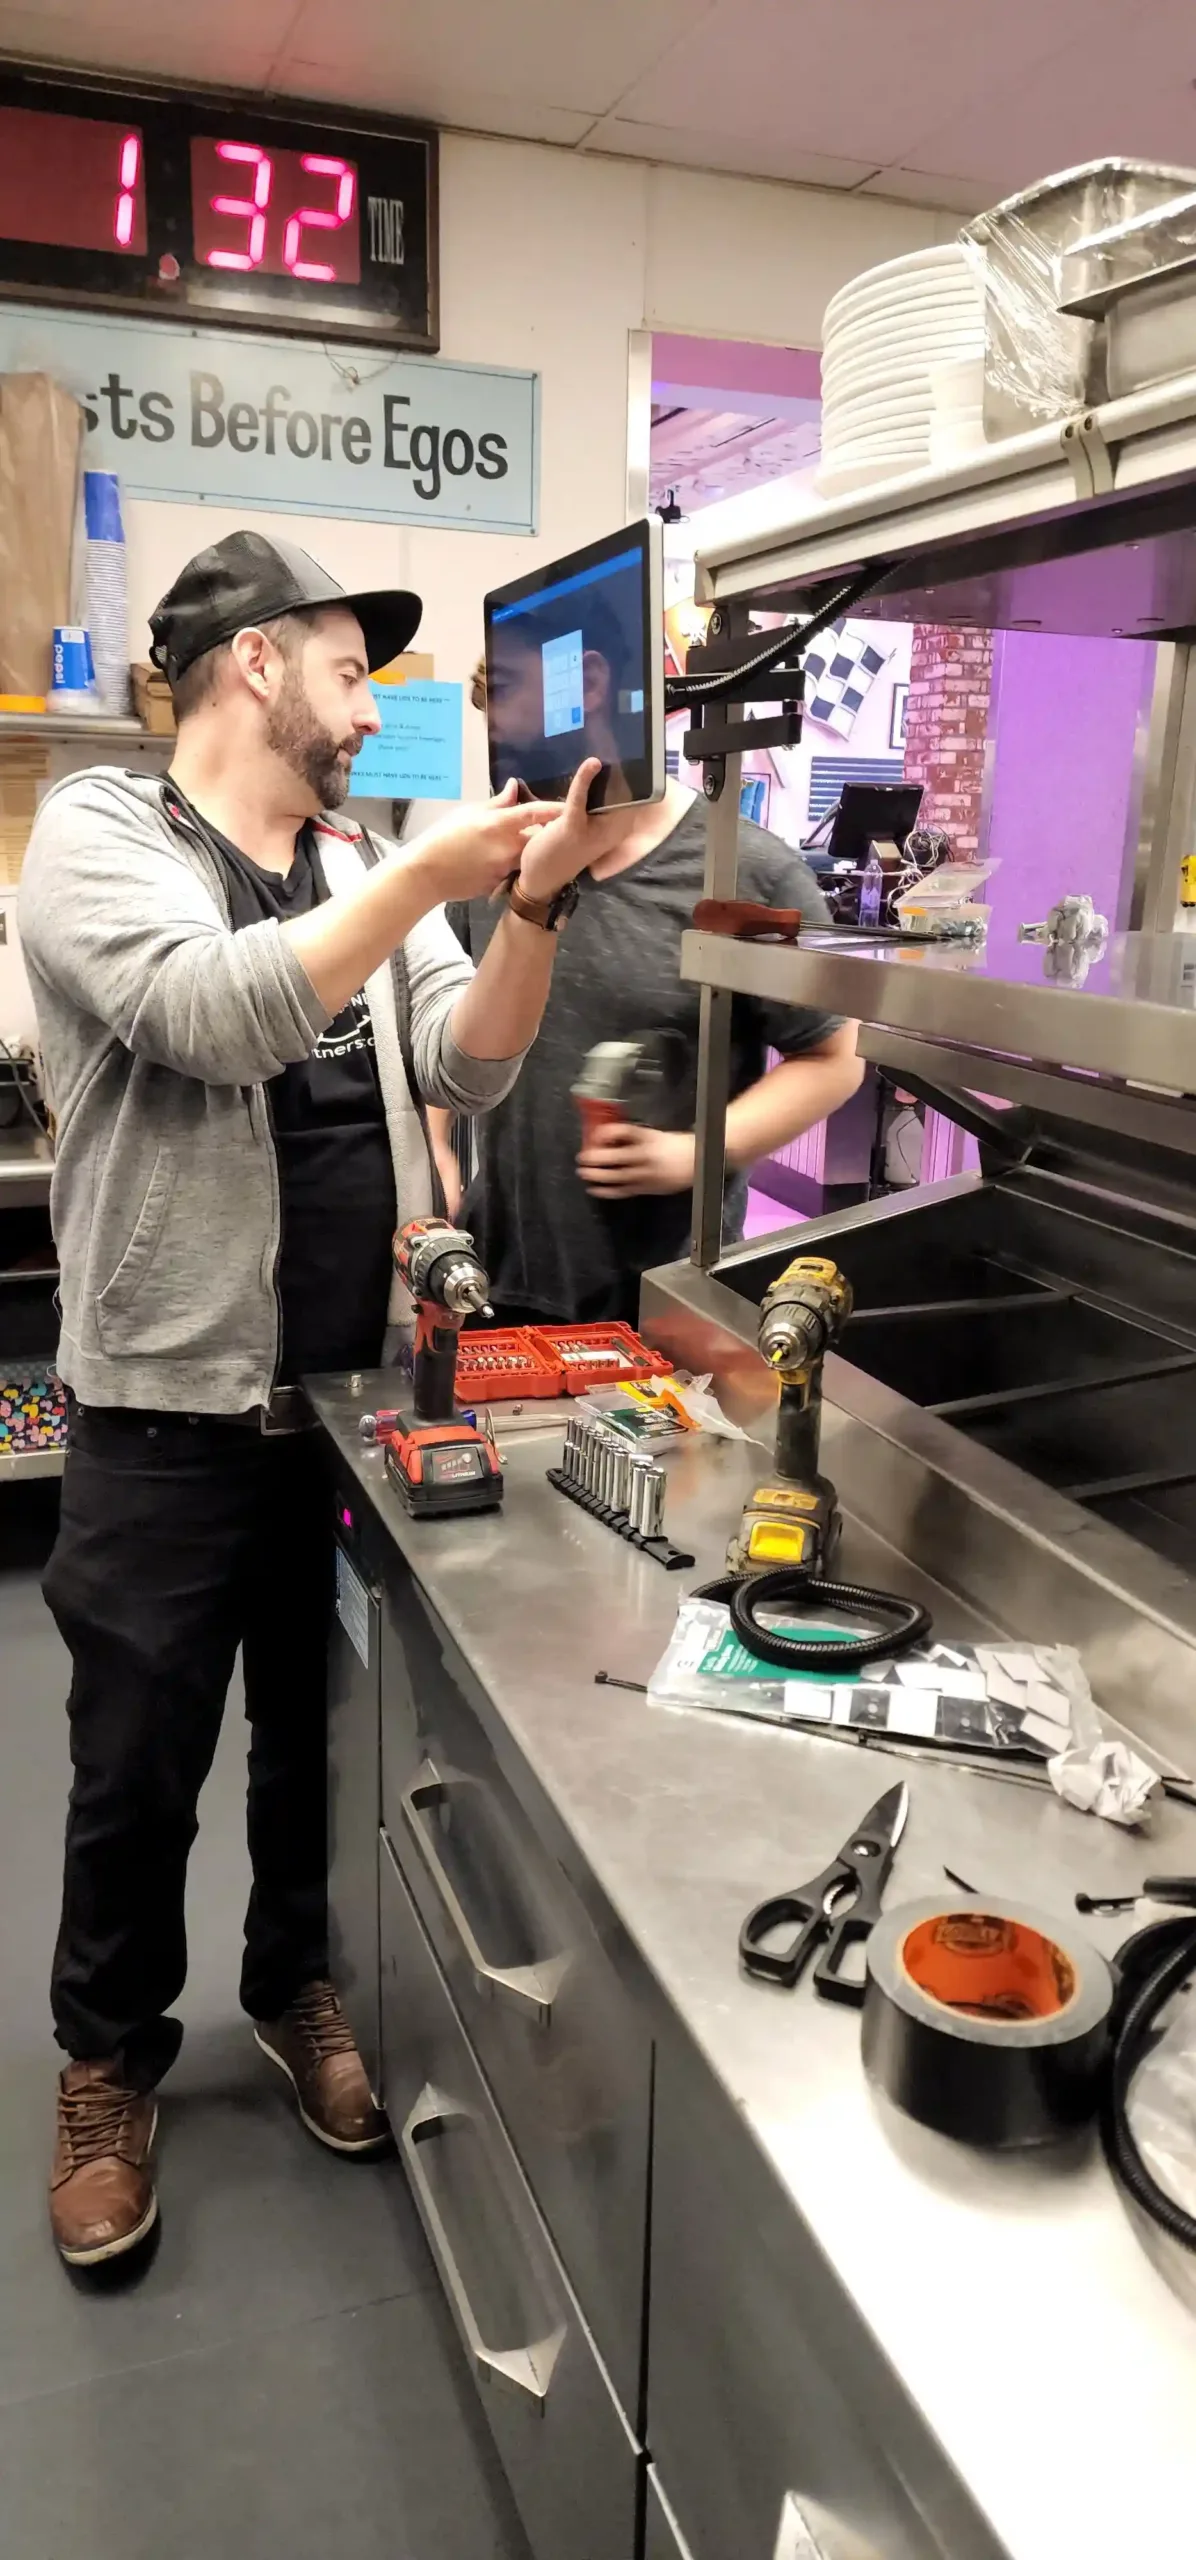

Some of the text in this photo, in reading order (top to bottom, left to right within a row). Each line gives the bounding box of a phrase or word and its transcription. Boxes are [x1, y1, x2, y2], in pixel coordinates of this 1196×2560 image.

[367, 196, 404, 265] TIME
[189, 369, 372, 466] Before
[383, 394, 509, 501] Egos
[54, 644, 66, 684] pepsi
